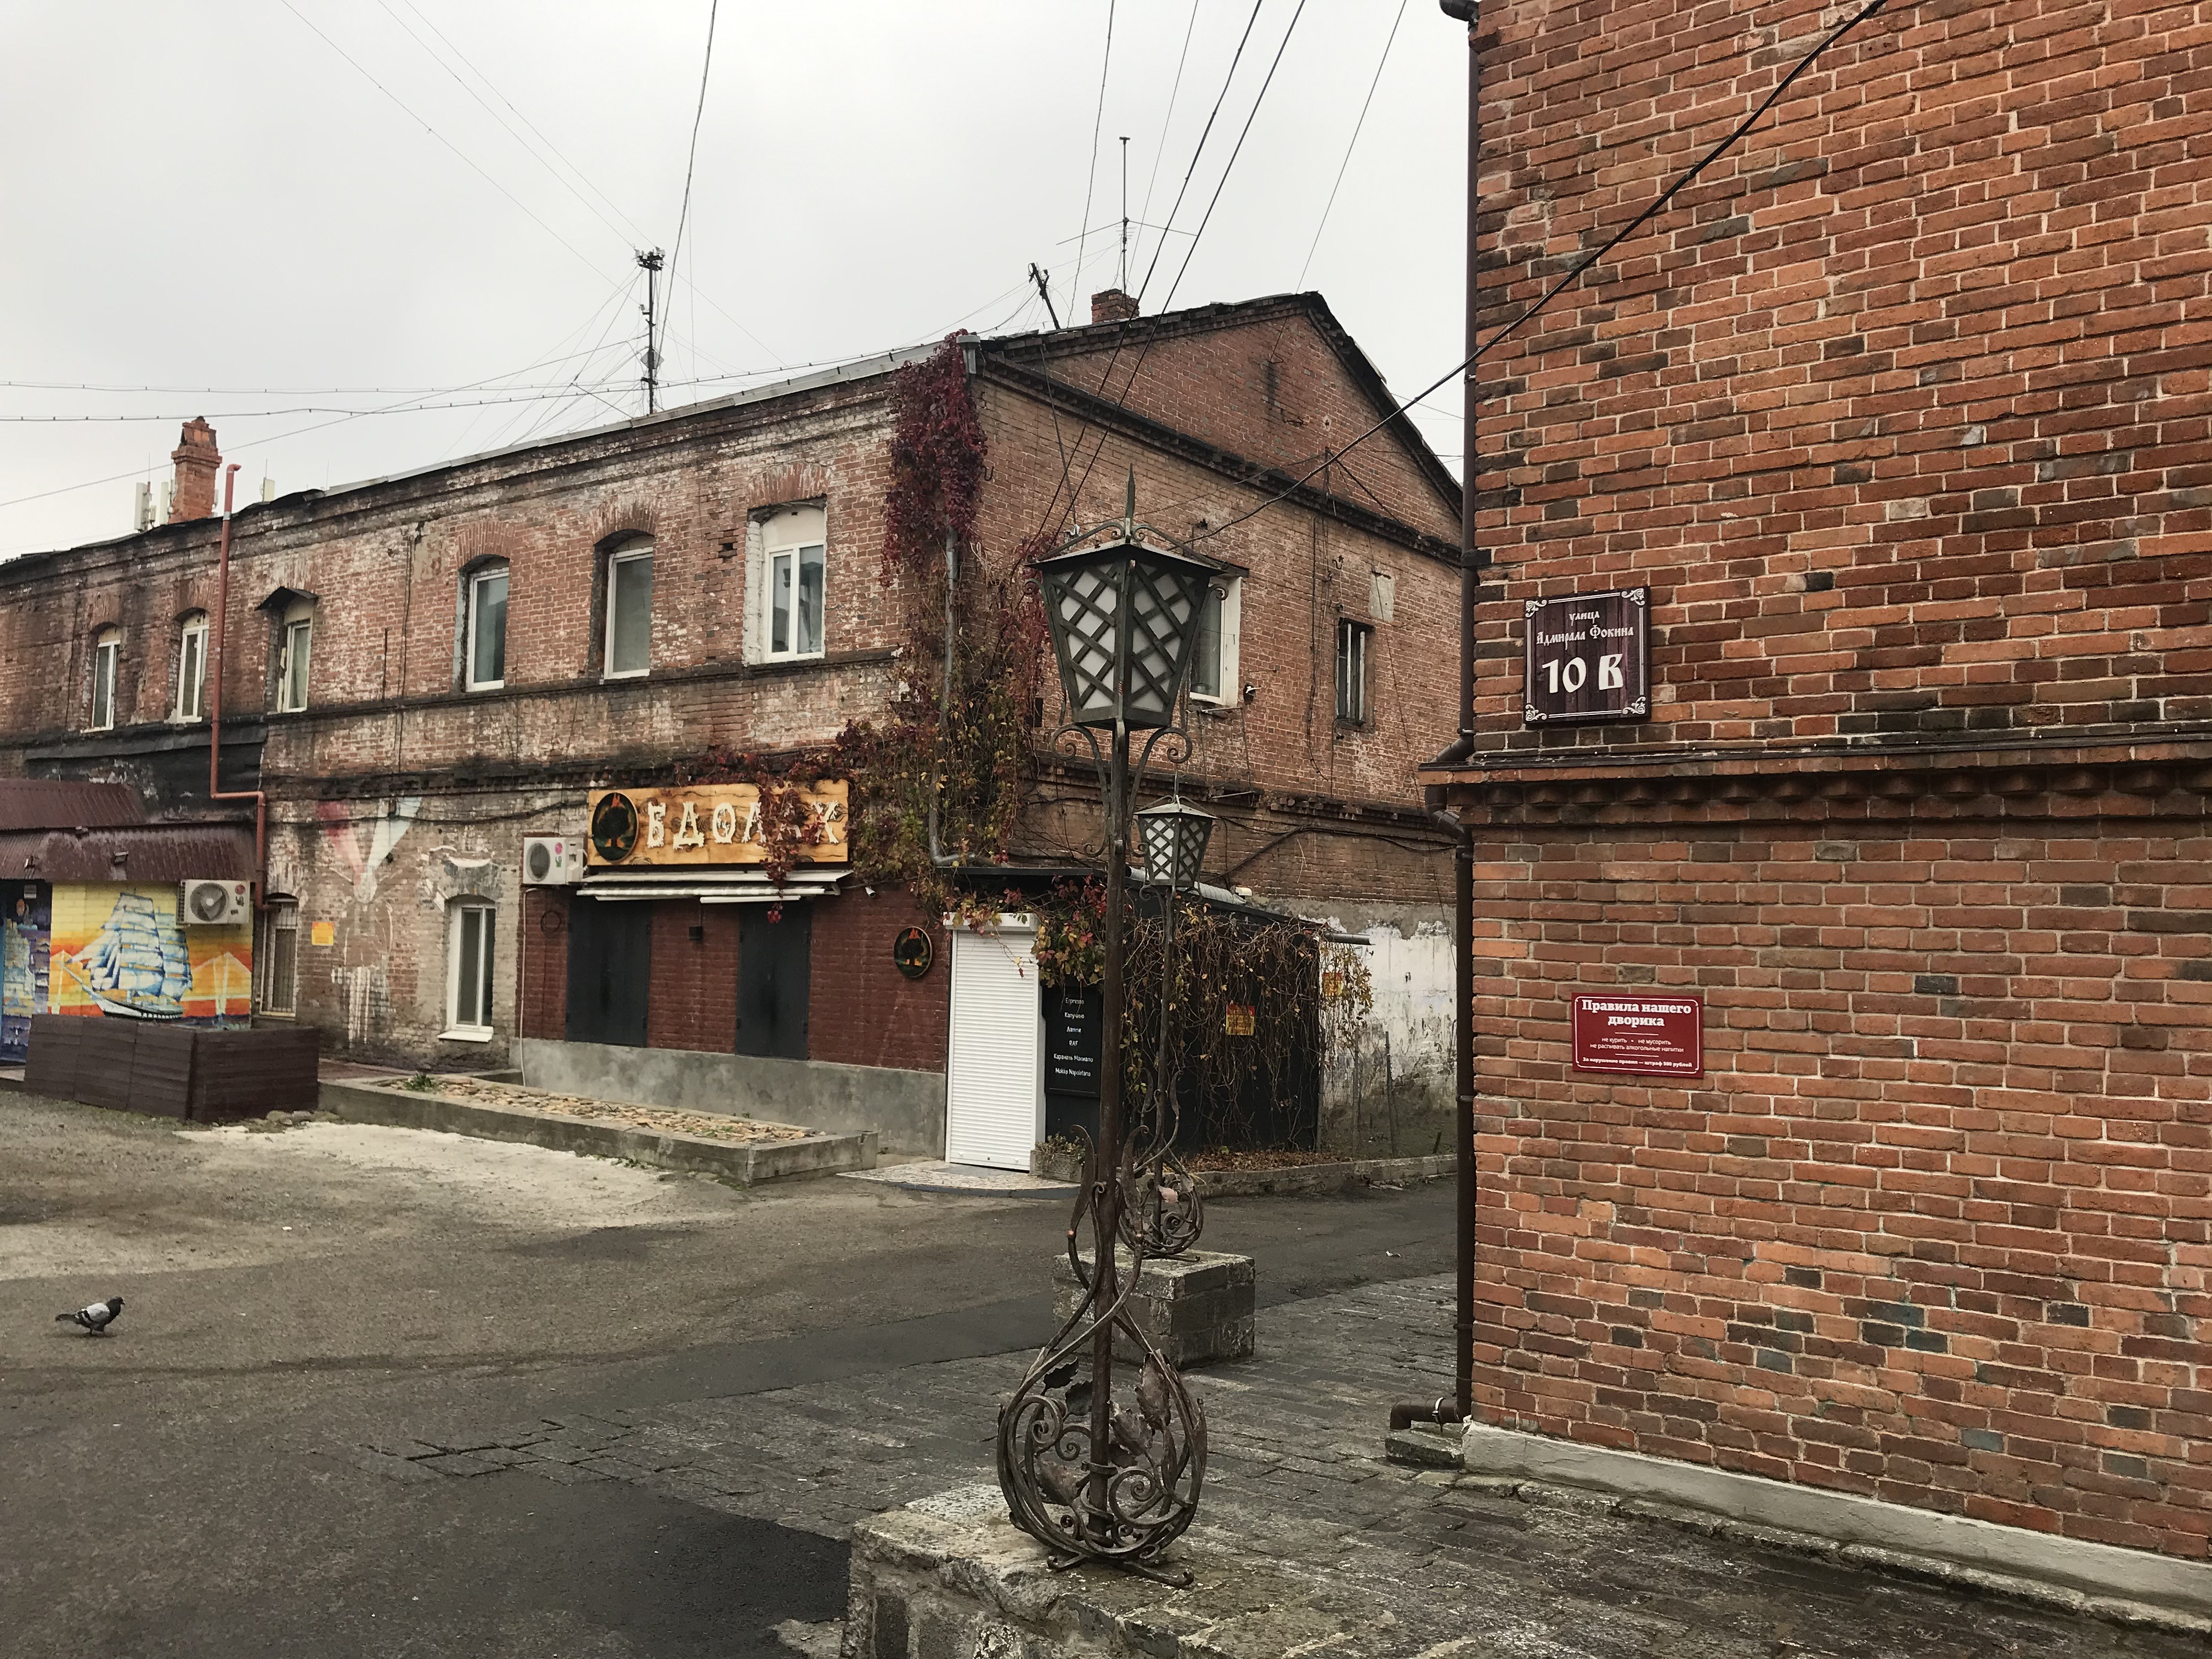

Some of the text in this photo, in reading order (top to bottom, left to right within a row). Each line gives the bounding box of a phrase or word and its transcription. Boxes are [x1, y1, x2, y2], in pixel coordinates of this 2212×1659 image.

[1568, 611, 1600, 627] улица
[1536, 624, 1634, 650] Адмирала Фокина
[1542, 653, 1624, 693] 10 В
[1582, 999, 1691, 1014] Правила нашего
[1607, 1015, 1664, 1028] дворика
